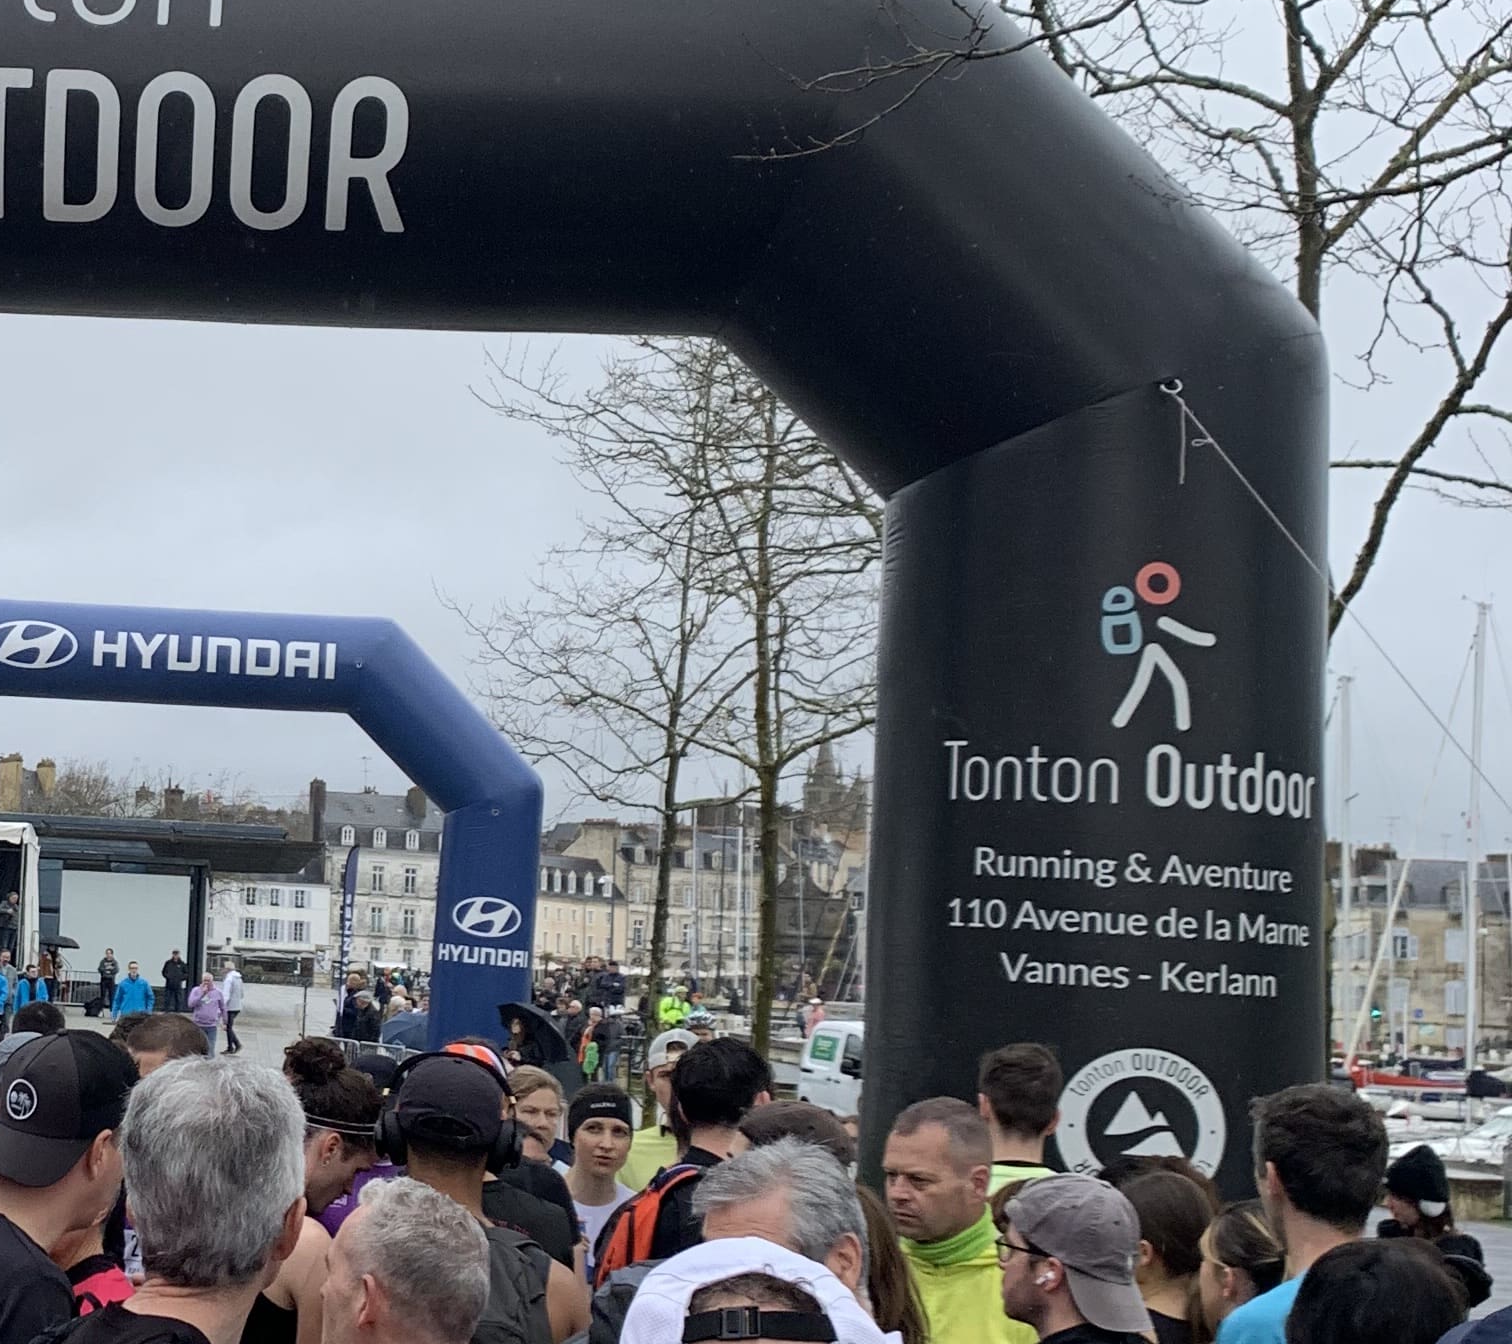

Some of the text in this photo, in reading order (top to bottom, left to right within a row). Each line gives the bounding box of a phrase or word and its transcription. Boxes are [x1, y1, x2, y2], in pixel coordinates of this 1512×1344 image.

[92, 629, 338, 681] HYUNDAI
[944, 740, 1317, 820] Tonton Outdoor
[973, 846, 1294, 894] Running & Aventure
[948, 898, 1311, 948] 110 Avenue de la Marne
[438, 942, 529, 969] HYUNDAI
[999, 951, 1130, 989] Vannes
[1160, 961, 1278, 998] Kerlann
[1068, 1053, 1210, 1100] tonton OUTDOOR
